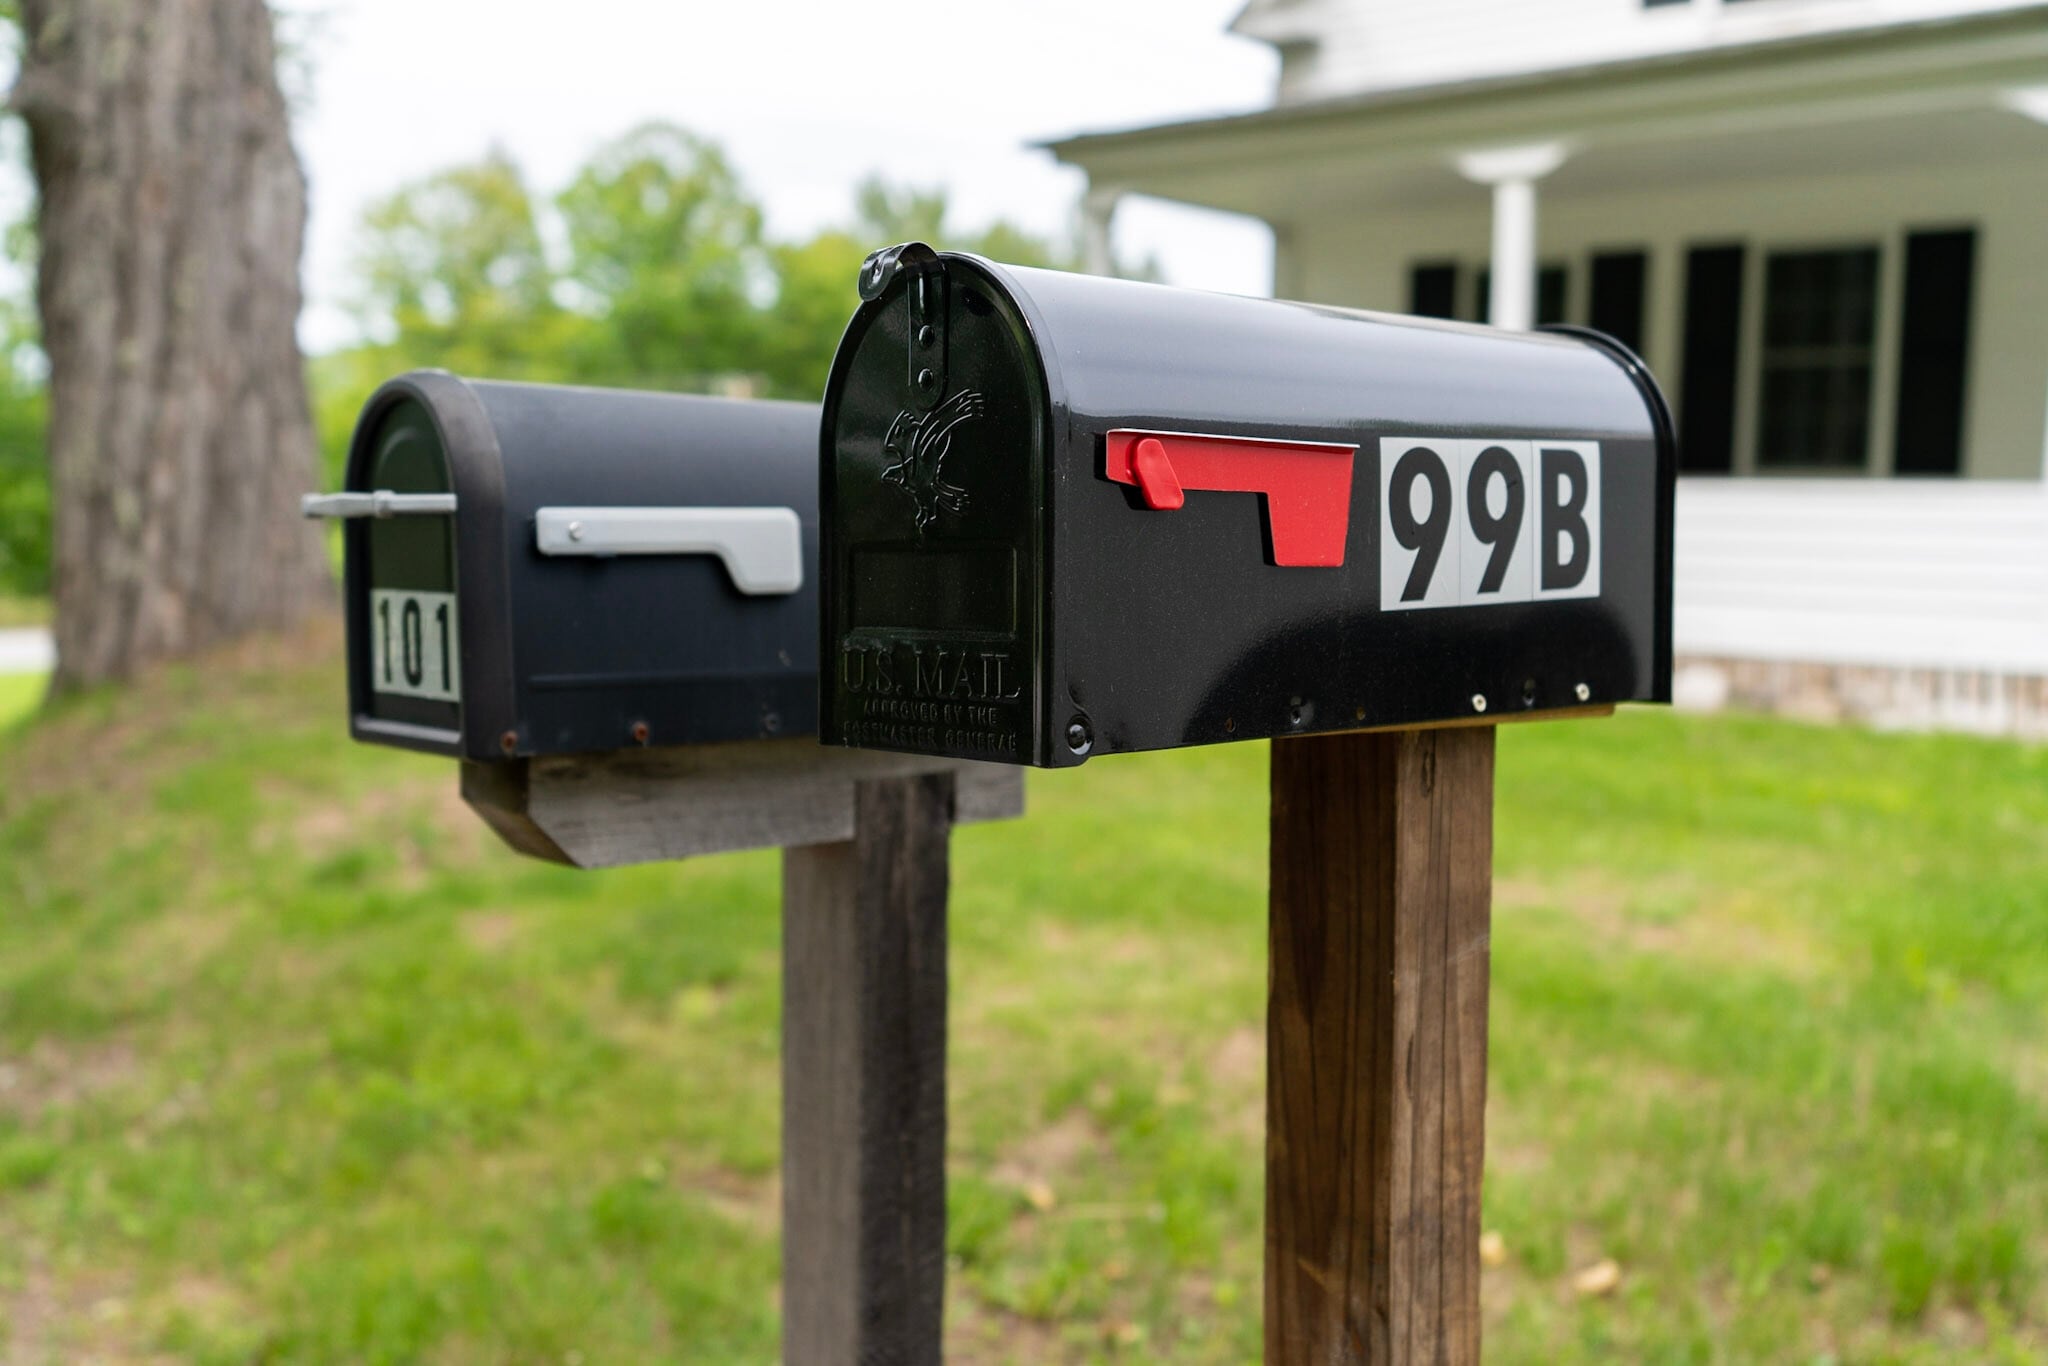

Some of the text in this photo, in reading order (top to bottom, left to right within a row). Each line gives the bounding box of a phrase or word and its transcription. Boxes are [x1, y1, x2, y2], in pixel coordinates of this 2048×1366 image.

[1388, 445, 1591, 602] 99B
[379, 597, 451, 693] 101
[843, 648, 1021, 699] U.S. MAIL
[967, 705, 1000, 726] THE
